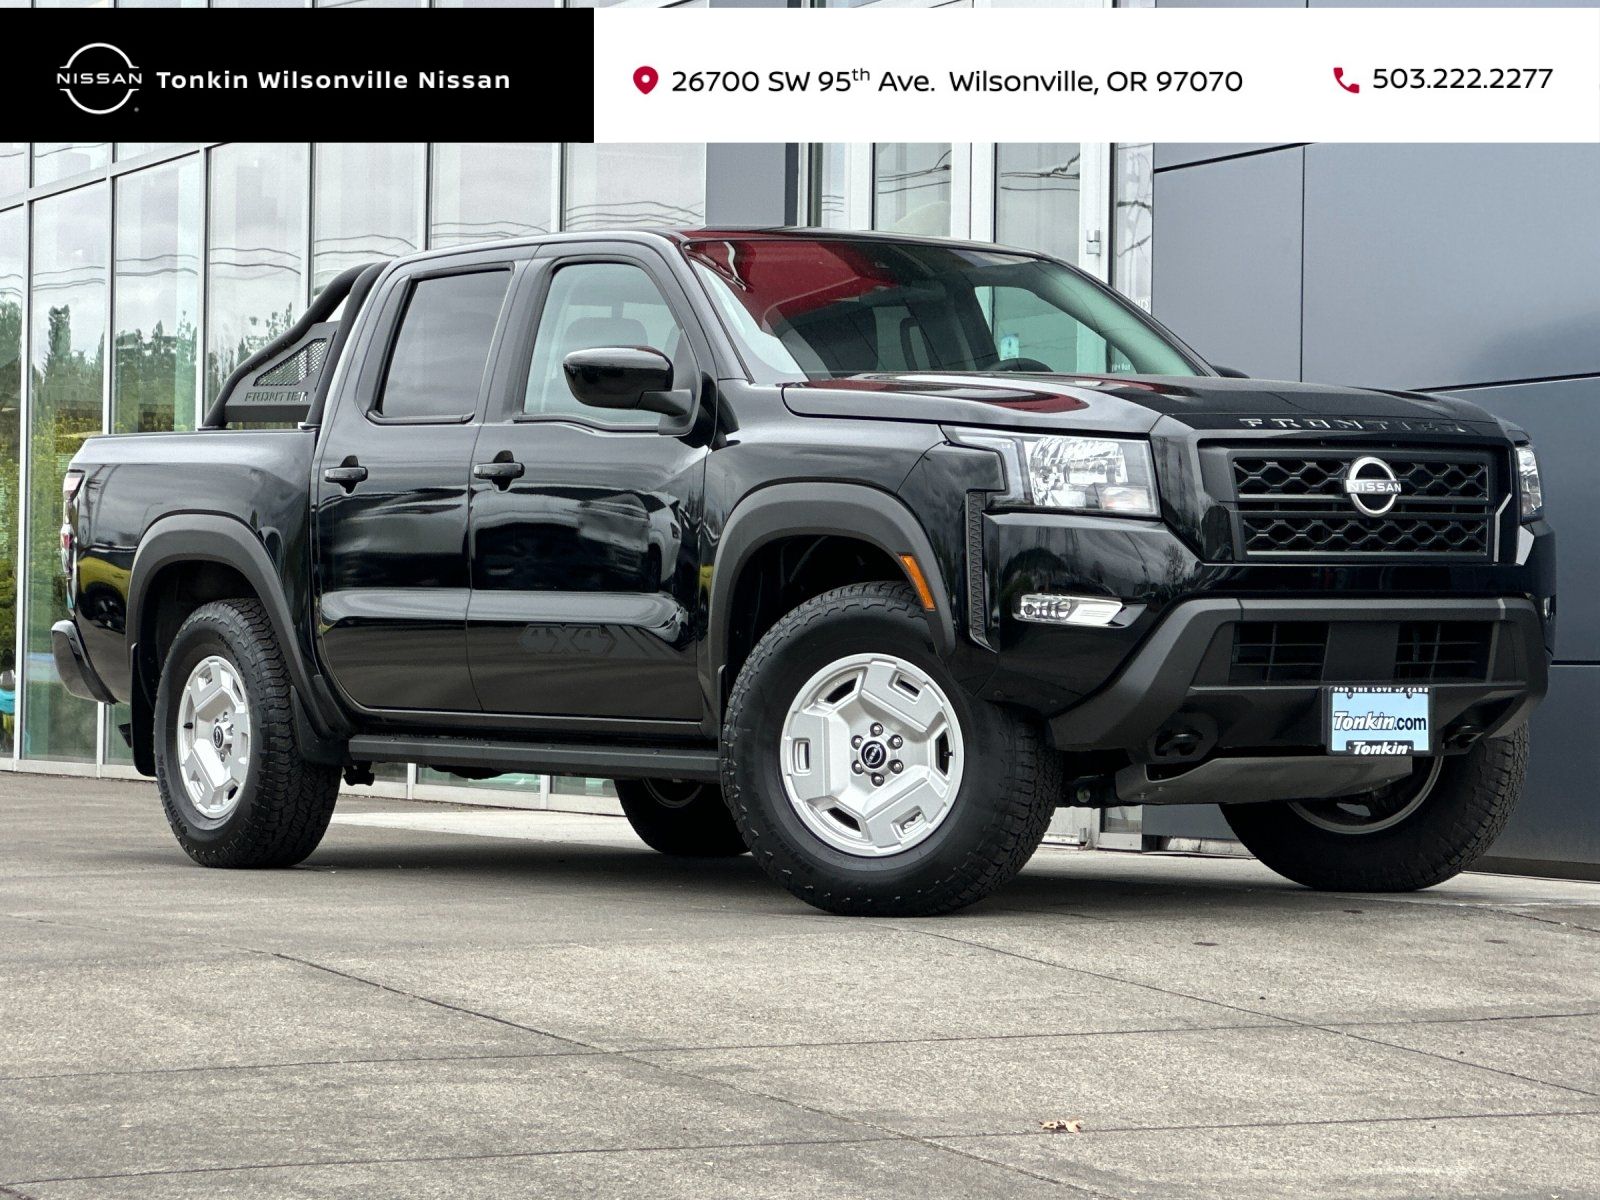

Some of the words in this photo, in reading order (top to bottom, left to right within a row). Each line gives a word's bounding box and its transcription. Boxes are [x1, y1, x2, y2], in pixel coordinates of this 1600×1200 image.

[244, 391, 309, 402] FRONTIER
[1348, 481, 1402, 493] NISSAN
[1333, 710, 1427, 731] Tonkin.com
[1352, 741, 1409, 755] Tonkin
